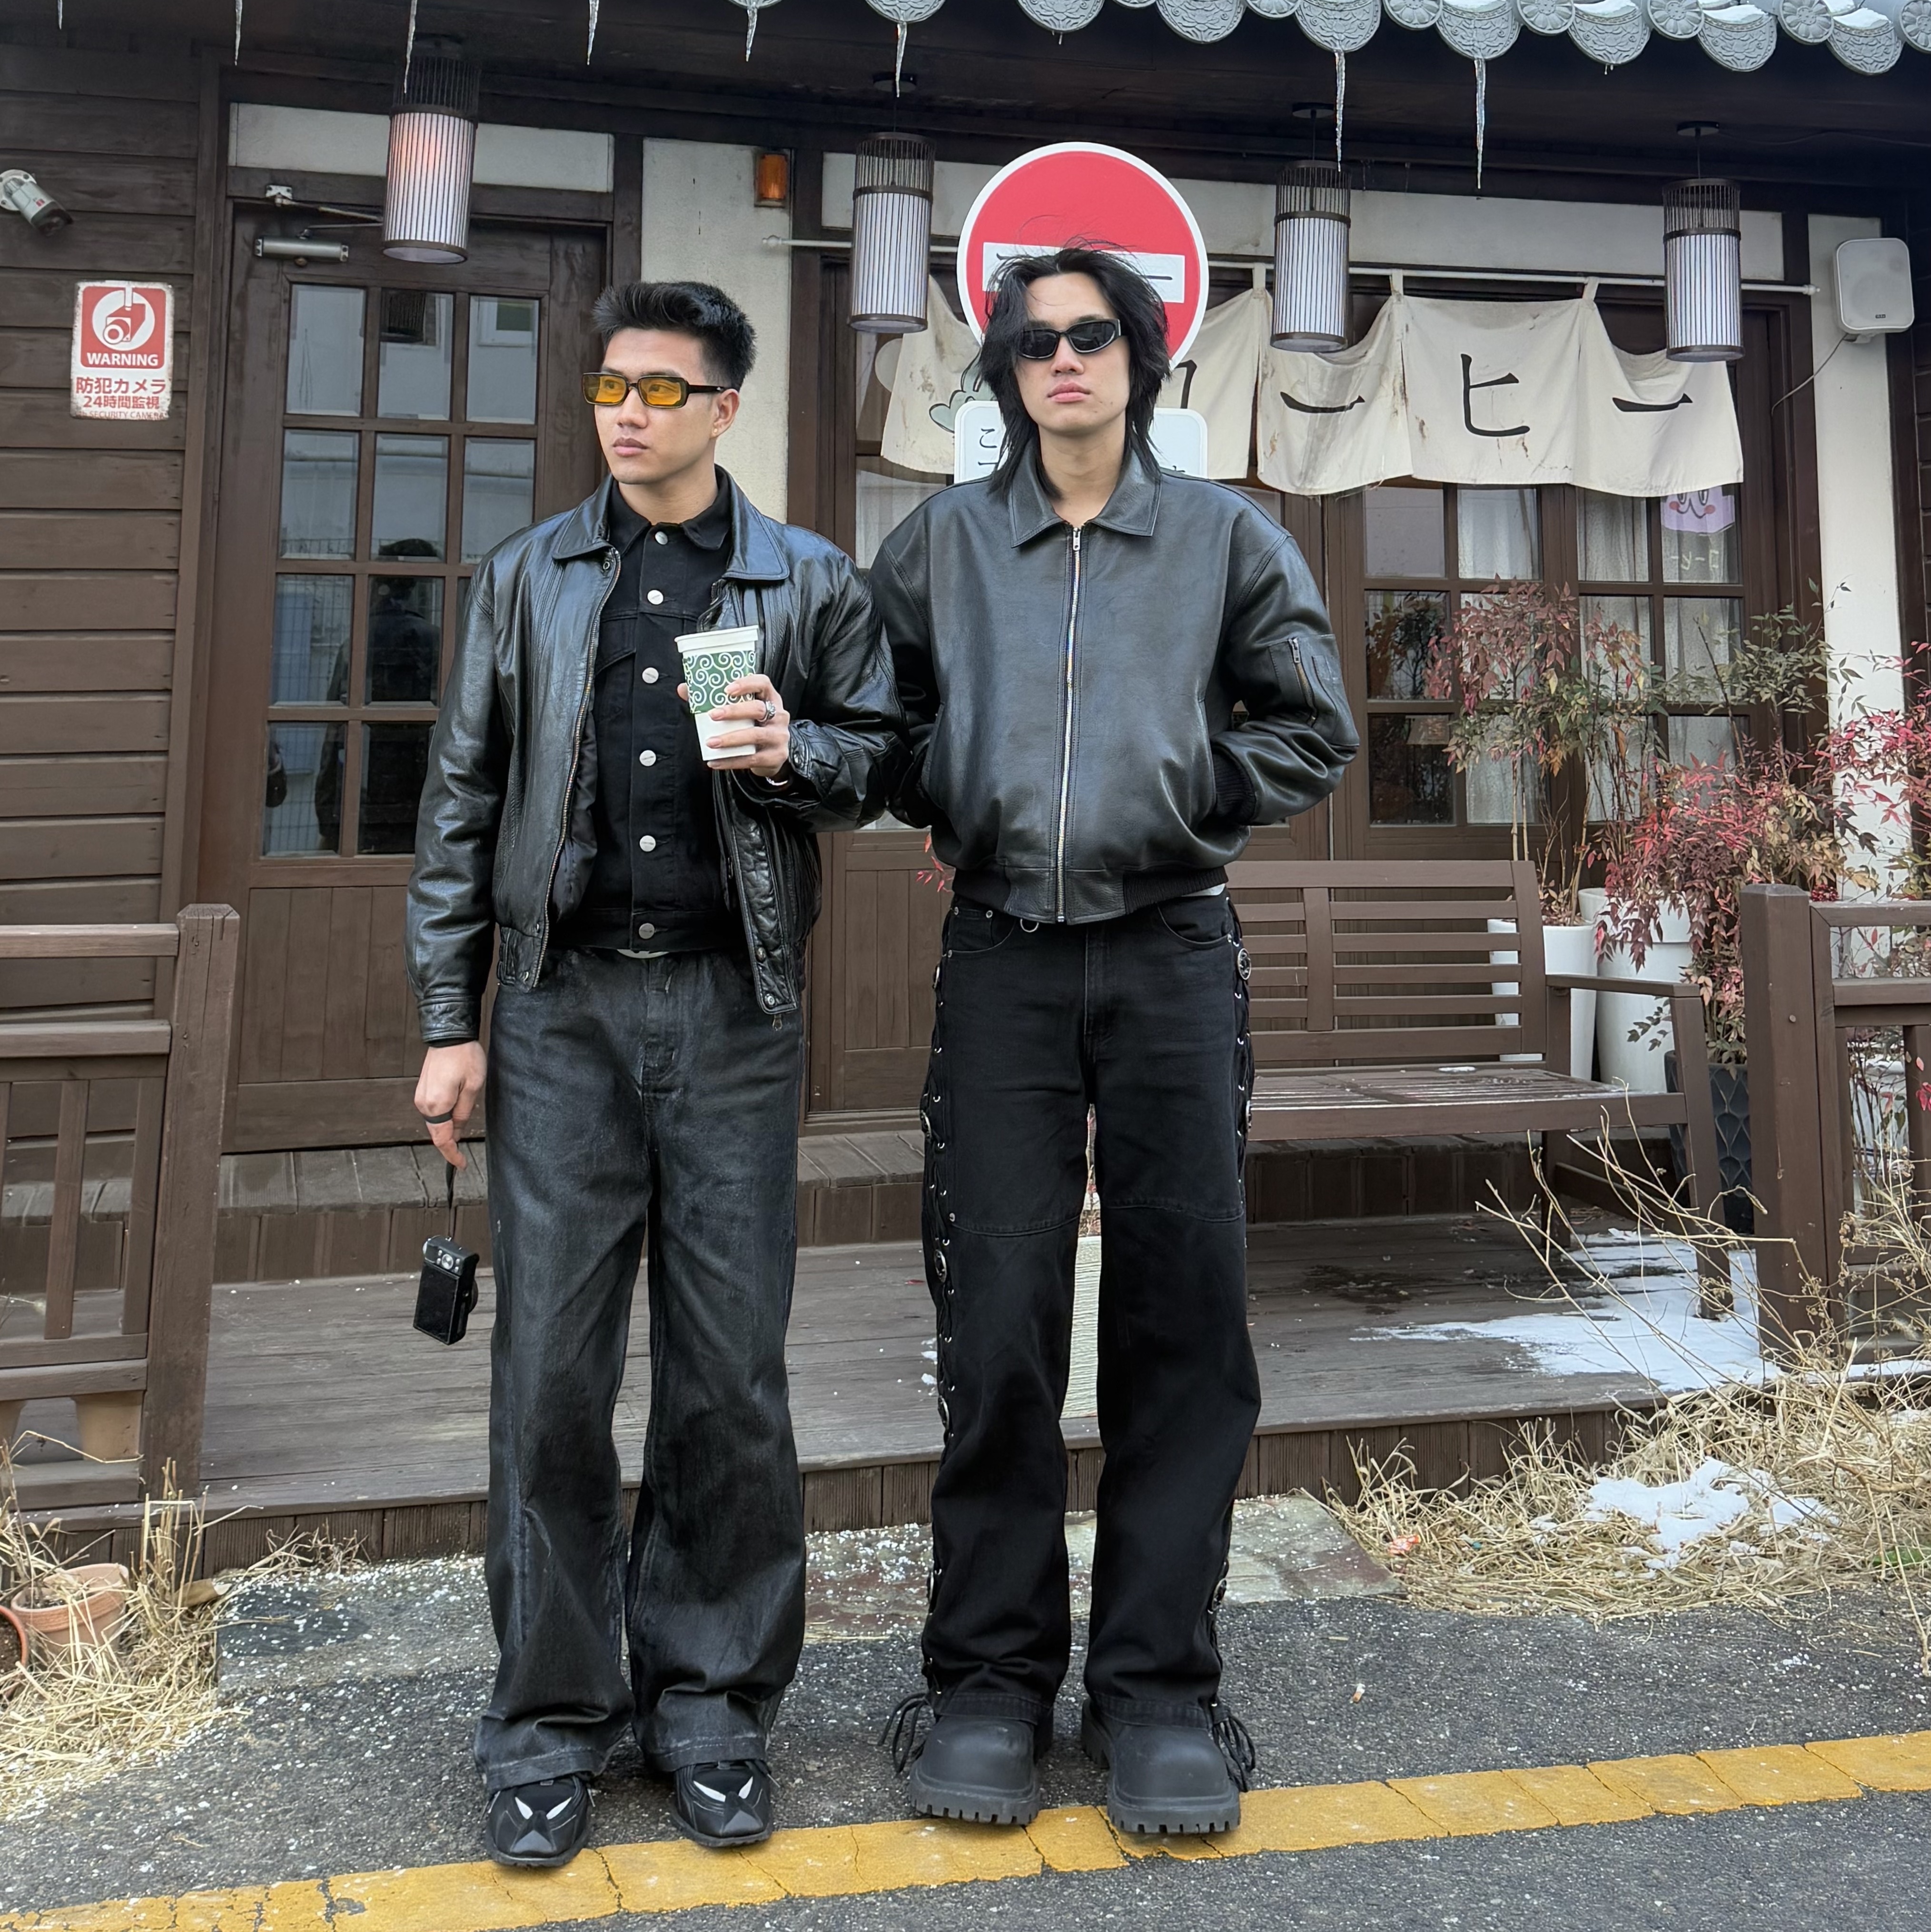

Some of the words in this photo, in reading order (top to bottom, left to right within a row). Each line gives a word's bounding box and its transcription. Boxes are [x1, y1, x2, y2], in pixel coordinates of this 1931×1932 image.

[87, 352, 158, 366] WARNING
[76, 376, 166, 394] 防犯カメラ
[83, 395, 159, 409] 24時間監視
[89, 411, 128, 419] SECURITY
[130, 411, 164, 420] CAMERA
